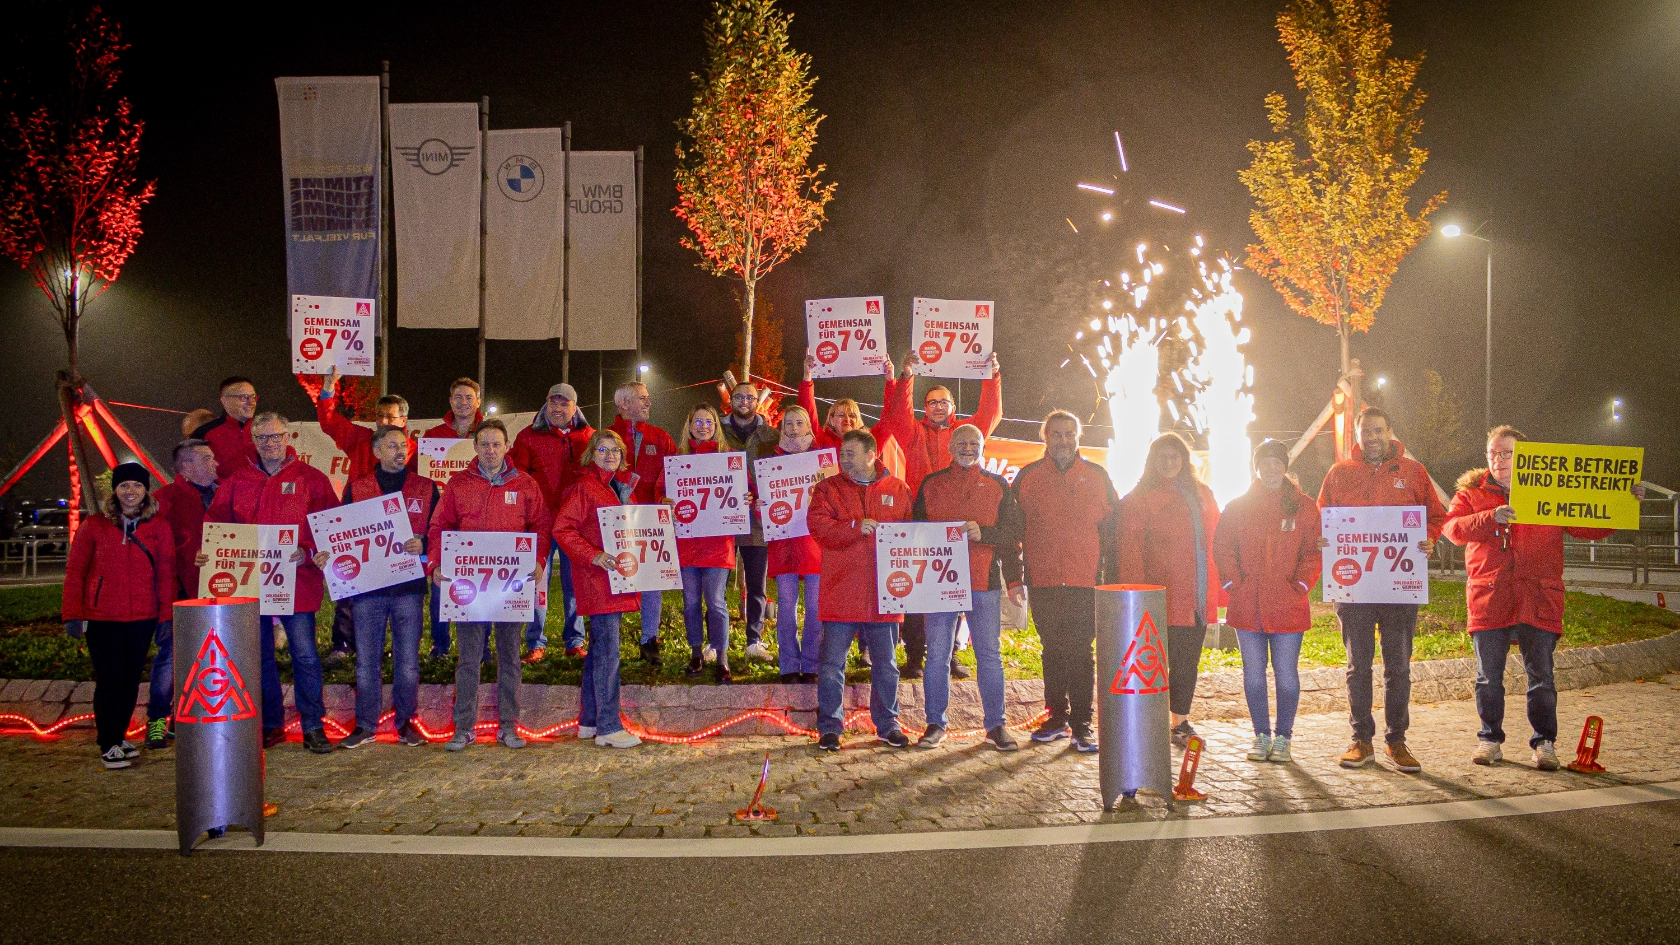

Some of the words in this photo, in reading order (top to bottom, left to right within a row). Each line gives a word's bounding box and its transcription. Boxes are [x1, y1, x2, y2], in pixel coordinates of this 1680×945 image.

[304, 318, 360, 327] GEMEINSAM
[818, 319, 871, 329] GEMEINSAM
[924, 320, 979, 330] GEMEINSAM
[304, 326, 320, 336] FÜR
[819, 330, 835, 339] FÜR
[924, 329, 940, 338] FÜR
[1516, 454, 1568, 472] DIESER
[1574, 456, 1638, 475] BETRIEB
[430, 469, 446, 478] FÜR
[677, 475, 733, 487] GEMEINSAM
[769, 472, 826, 489] GEMEINSAM
[1517, 472, 1552, 487] WIRD
[678, 488, 694, 497] FÜR
[770, 489, 788, 499] FÜR
[1537, 501, 1552, 516] IG
[1556, 502, 1611, 519] METALL
[328, 520, 394, 542] GEMEINSAM
[614, 528, 664, 538] GEMEINSAM
[1337, 533, 1408, 543] GEMEINSAM
[332, 542, 352, 554] FÜR
[616, 540, 632, 550] FÜR
[1337, 544, 1358, 555] FÜR
[216, 548, 282, 558] GEMEINSAM
[890, 547, 952, 556] GEMEINSAM
[215, 559, 235, 569] FÜR
[455, 556, 520, 565] GEMEINSAM
[890, 558, 909, 568] FÜR
[454, 566, 474, 576] FÜR
